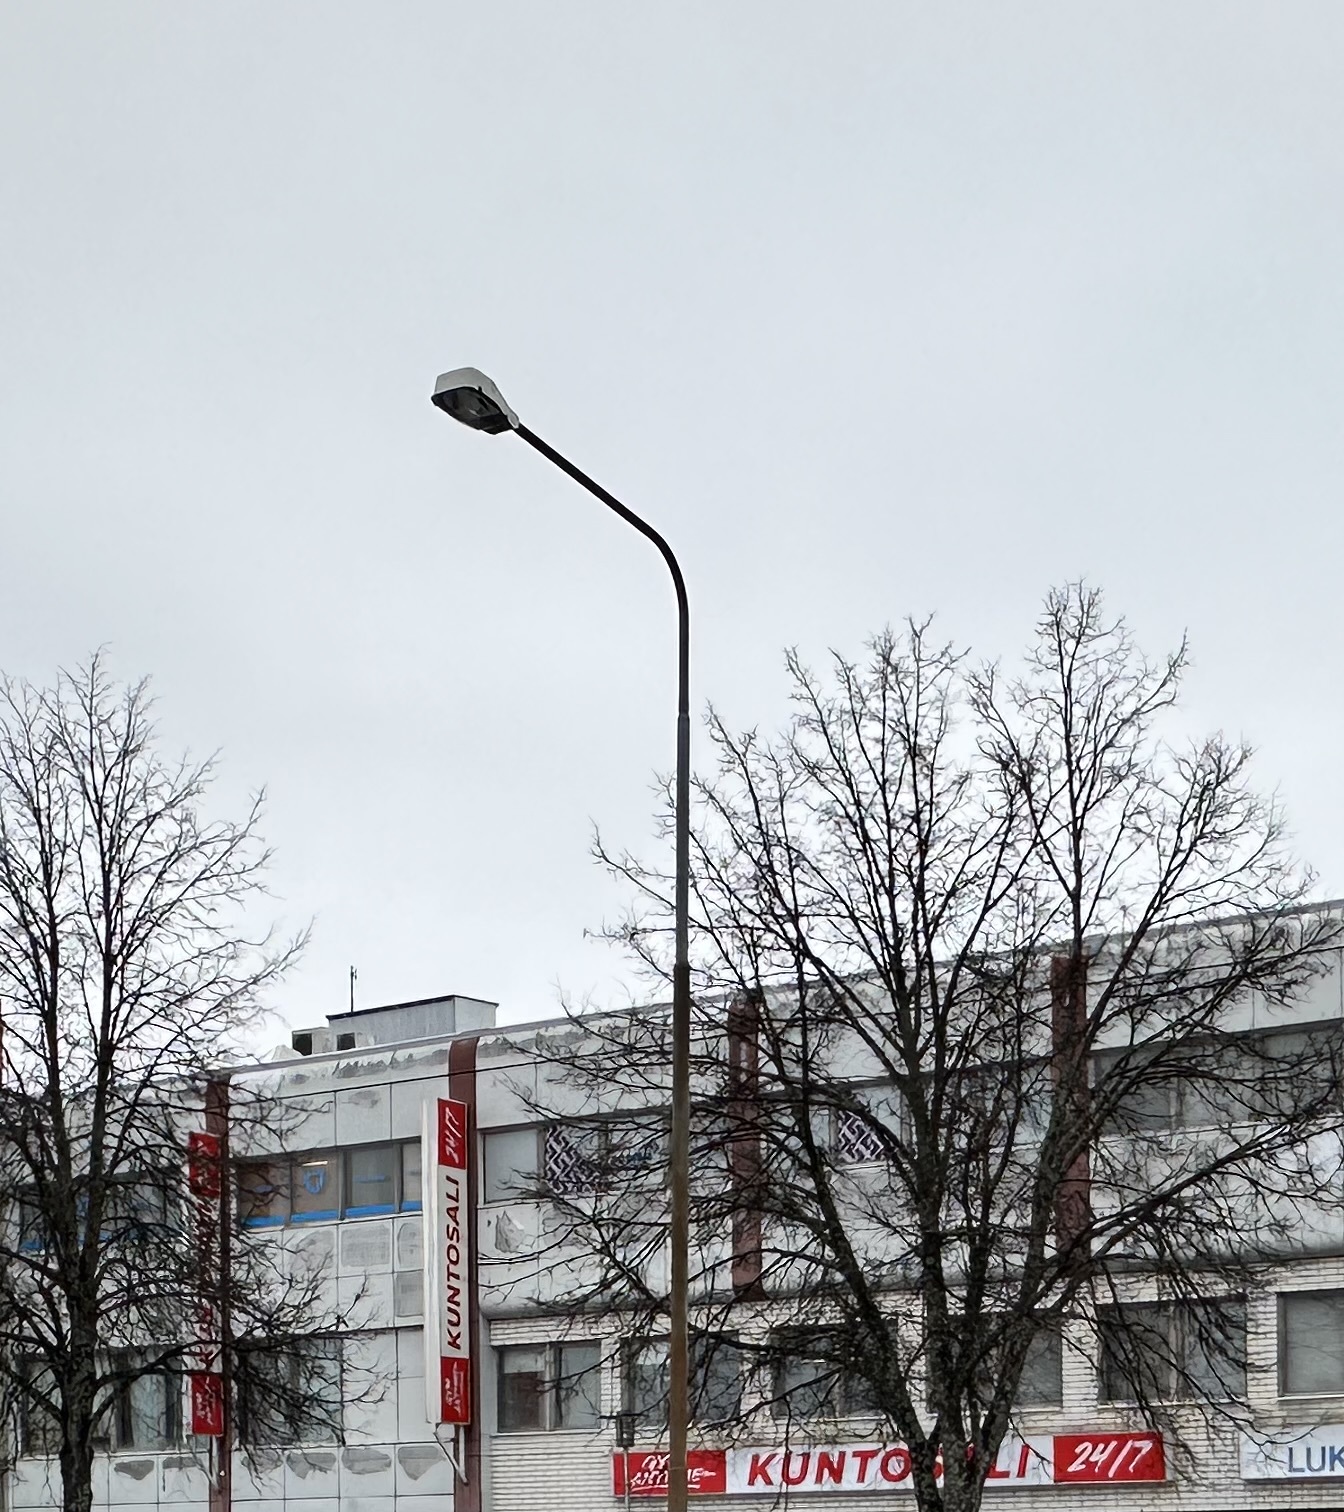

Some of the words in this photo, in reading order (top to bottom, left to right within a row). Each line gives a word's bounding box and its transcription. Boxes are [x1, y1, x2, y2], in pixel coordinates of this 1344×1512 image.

[446, 1175, 462, 1350] KUNTOSALI
[747, 1443, 1031, 1487] KUNTOLI
[1067, 1439, 1153, 1478] 24/7
